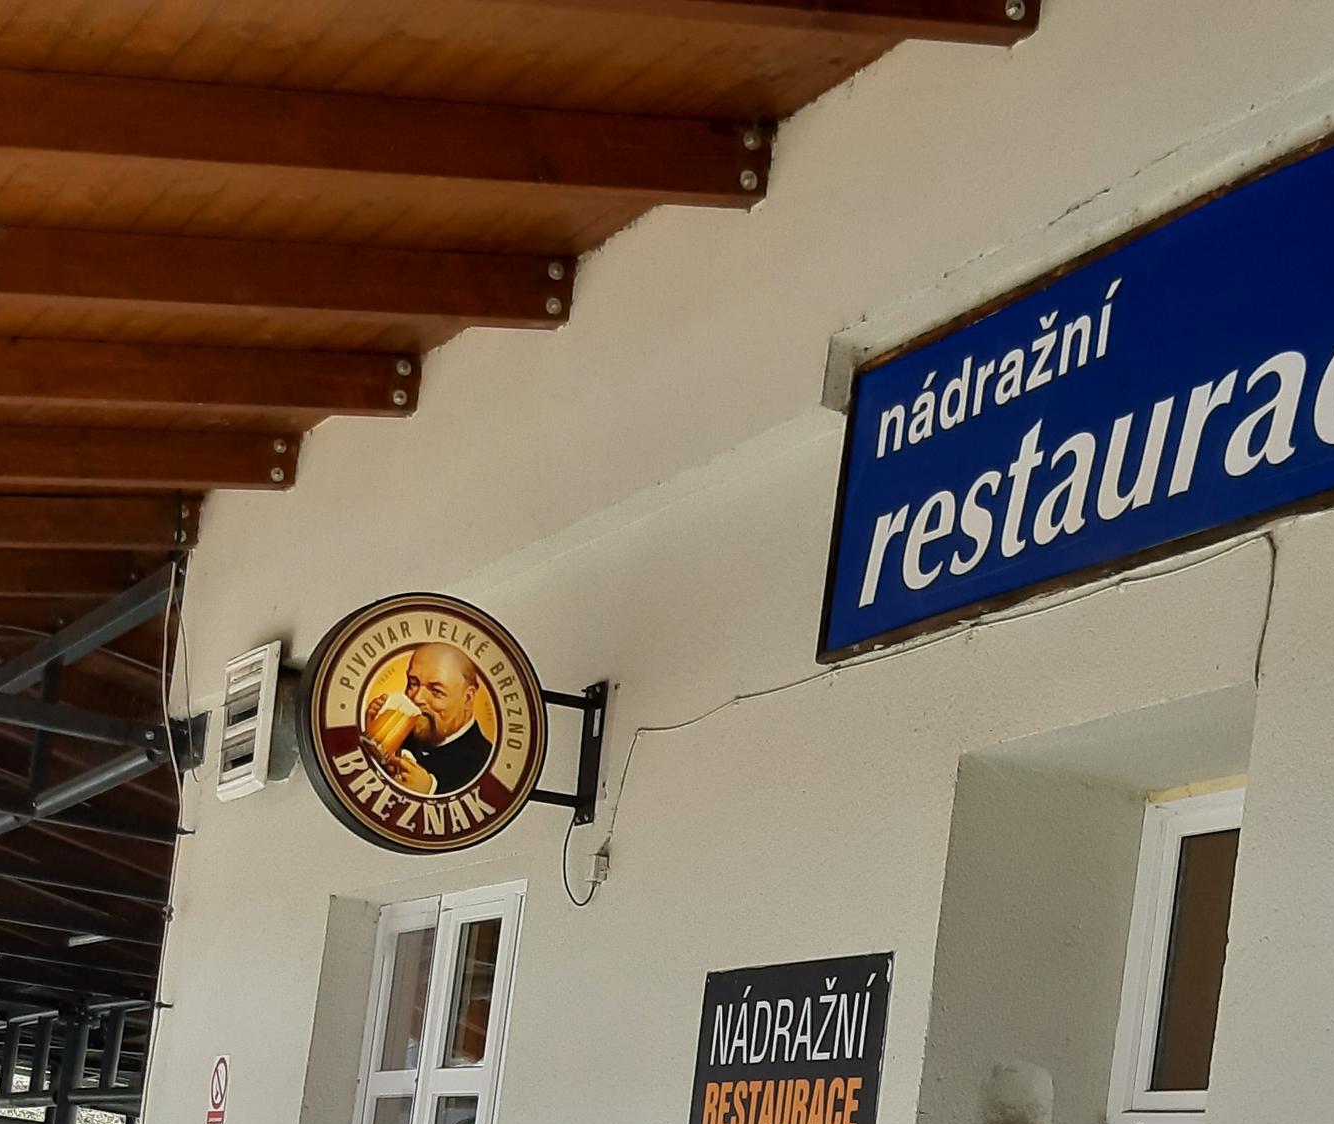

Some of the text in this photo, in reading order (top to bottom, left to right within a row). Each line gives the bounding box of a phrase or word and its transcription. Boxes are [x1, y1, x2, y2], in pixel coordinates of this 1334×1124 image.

[877, 279, 1123, 458] nádražní
[339, 618, 524, 751] PIVOVAR VELKÉ BŘEZNO
[709, 972, 877, 1066] NÁDRAŽNÍ
